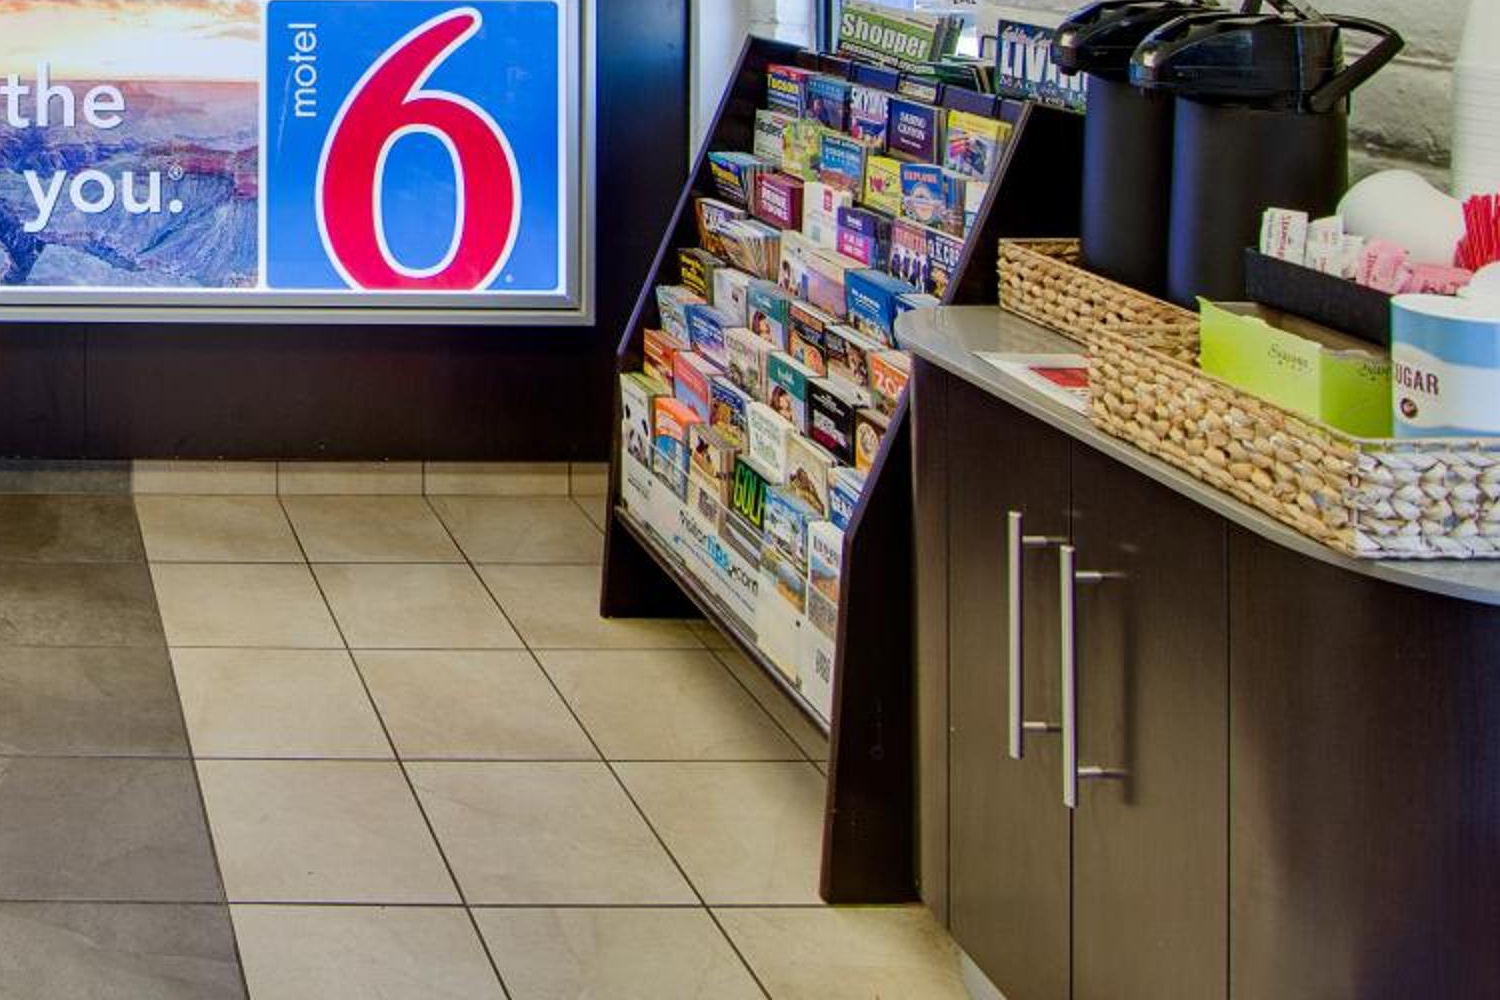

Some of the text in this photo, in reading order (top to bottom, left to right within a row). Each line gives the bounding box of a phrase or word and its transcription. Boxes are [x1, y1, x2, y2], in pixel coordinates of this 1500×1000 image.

[841, 12, 929, 59] Shopper
[0, 60, 126, 129] the
[287, 23, 317, 118] motel
[315, 6, 522, 292] 6
[1395, 363, 1440, 396] UGAR
